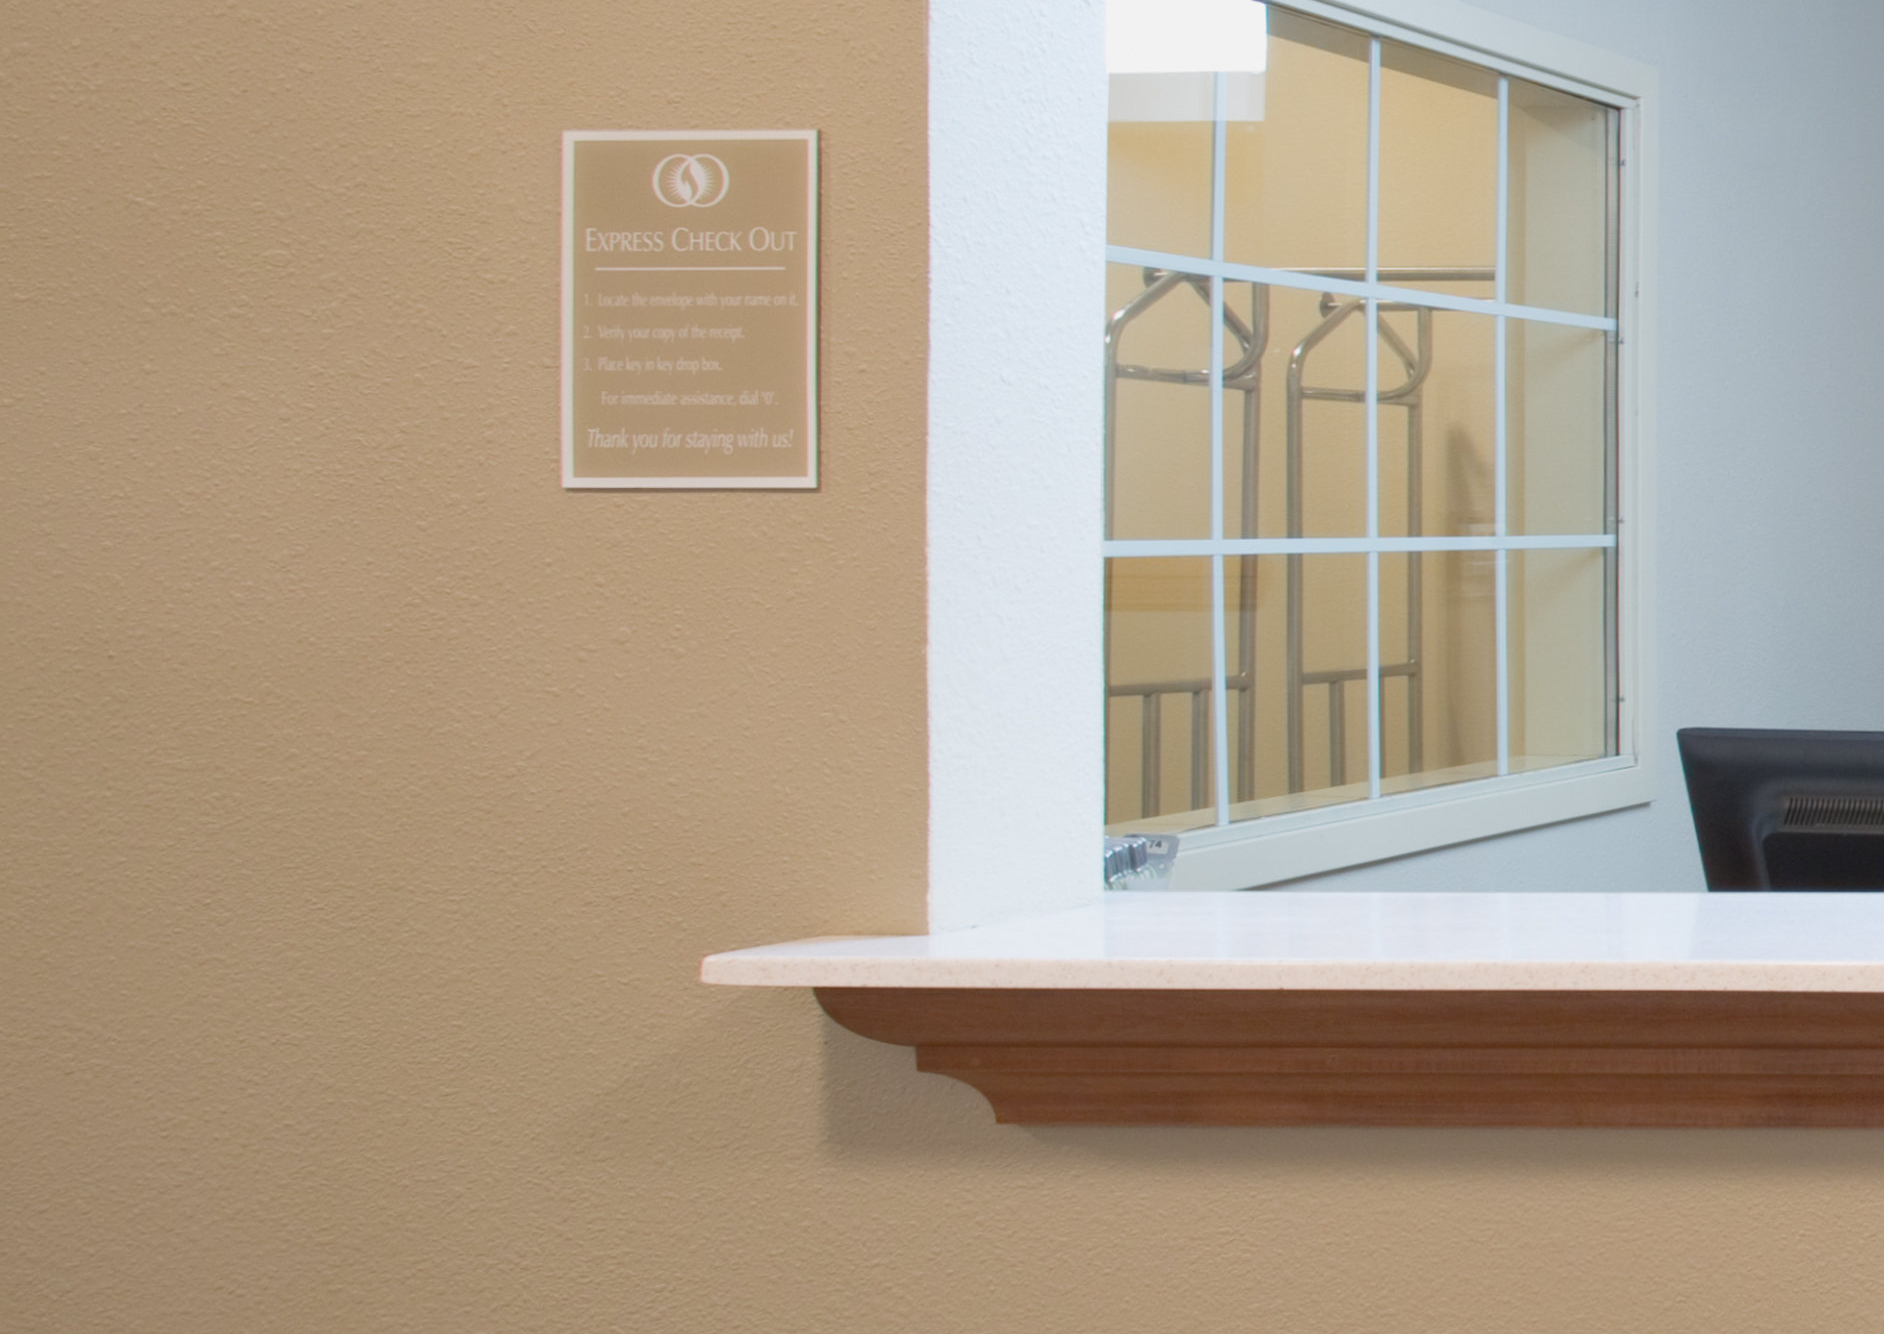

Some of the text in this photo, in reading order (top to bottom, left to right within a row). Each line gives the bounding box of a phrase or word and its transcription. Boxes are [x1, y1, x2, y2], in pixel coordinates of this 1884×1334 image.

[584, 226, 798, 252] EXPRESS CHECK OUT
[598, 293, 630, 308] Locate
[632, 293, 648, 307] the
[650, 293, 693, 310] envelope
[695, 293, 717, 307] with
[719, 296, 742, 311] your
[744, 296, 771, 307] name
[773, 296, 787, 307] on
[597, 325, 625, 341] Verify
[628, 329, 651, 343] your
[652, 329, 676, 343] copy
[678, 325, 690, 339] of
[691, 325, 707, 339] the
[598, 357, 624, 371] Place
[625, 357, 643, 375] key
[645, 357, 655, 371] in
[656, 357, 674, 375] key
[676, 357, 700, 375] drop
[601, 391, 618, 405] For
[621, 391, 677, 405] immediate
[739, 390, 758, 405] dial
[587, 428, 794, 456] Thank you for staying with us!
